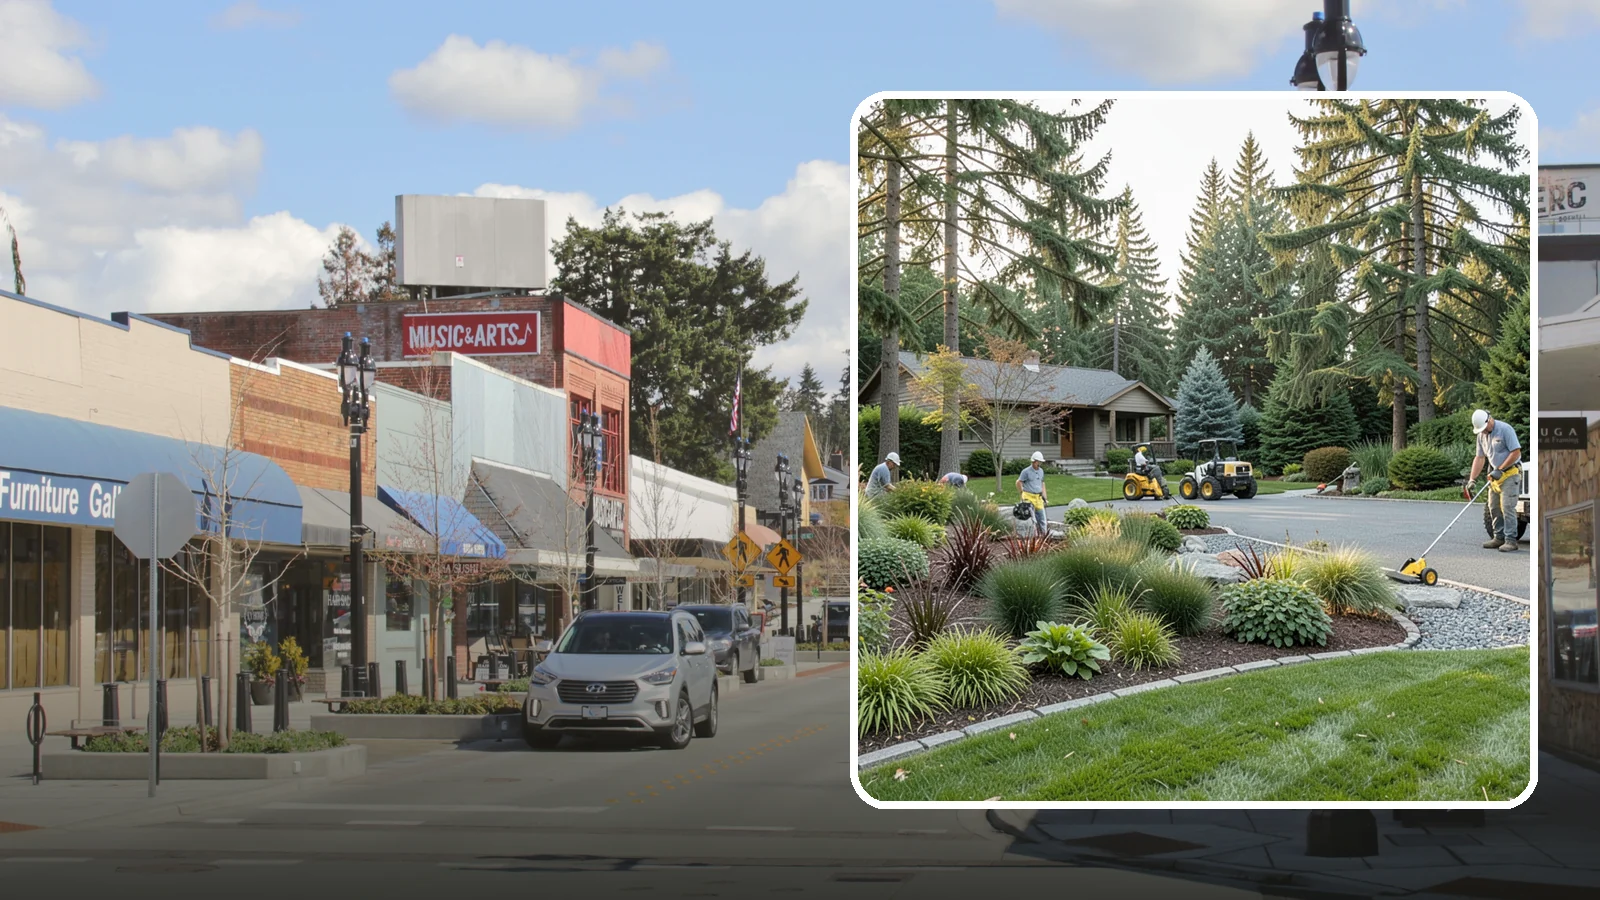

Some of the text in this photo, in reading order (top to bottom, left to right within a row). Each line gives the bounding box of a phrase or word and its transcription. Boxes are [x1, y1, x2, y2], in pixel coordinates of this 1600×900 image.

[408, 323, 520, 349] MUSIC&ARTS
[0, 471, 121, 519] Furniture Gal
[453, 563, 480, 574] SUSHI
